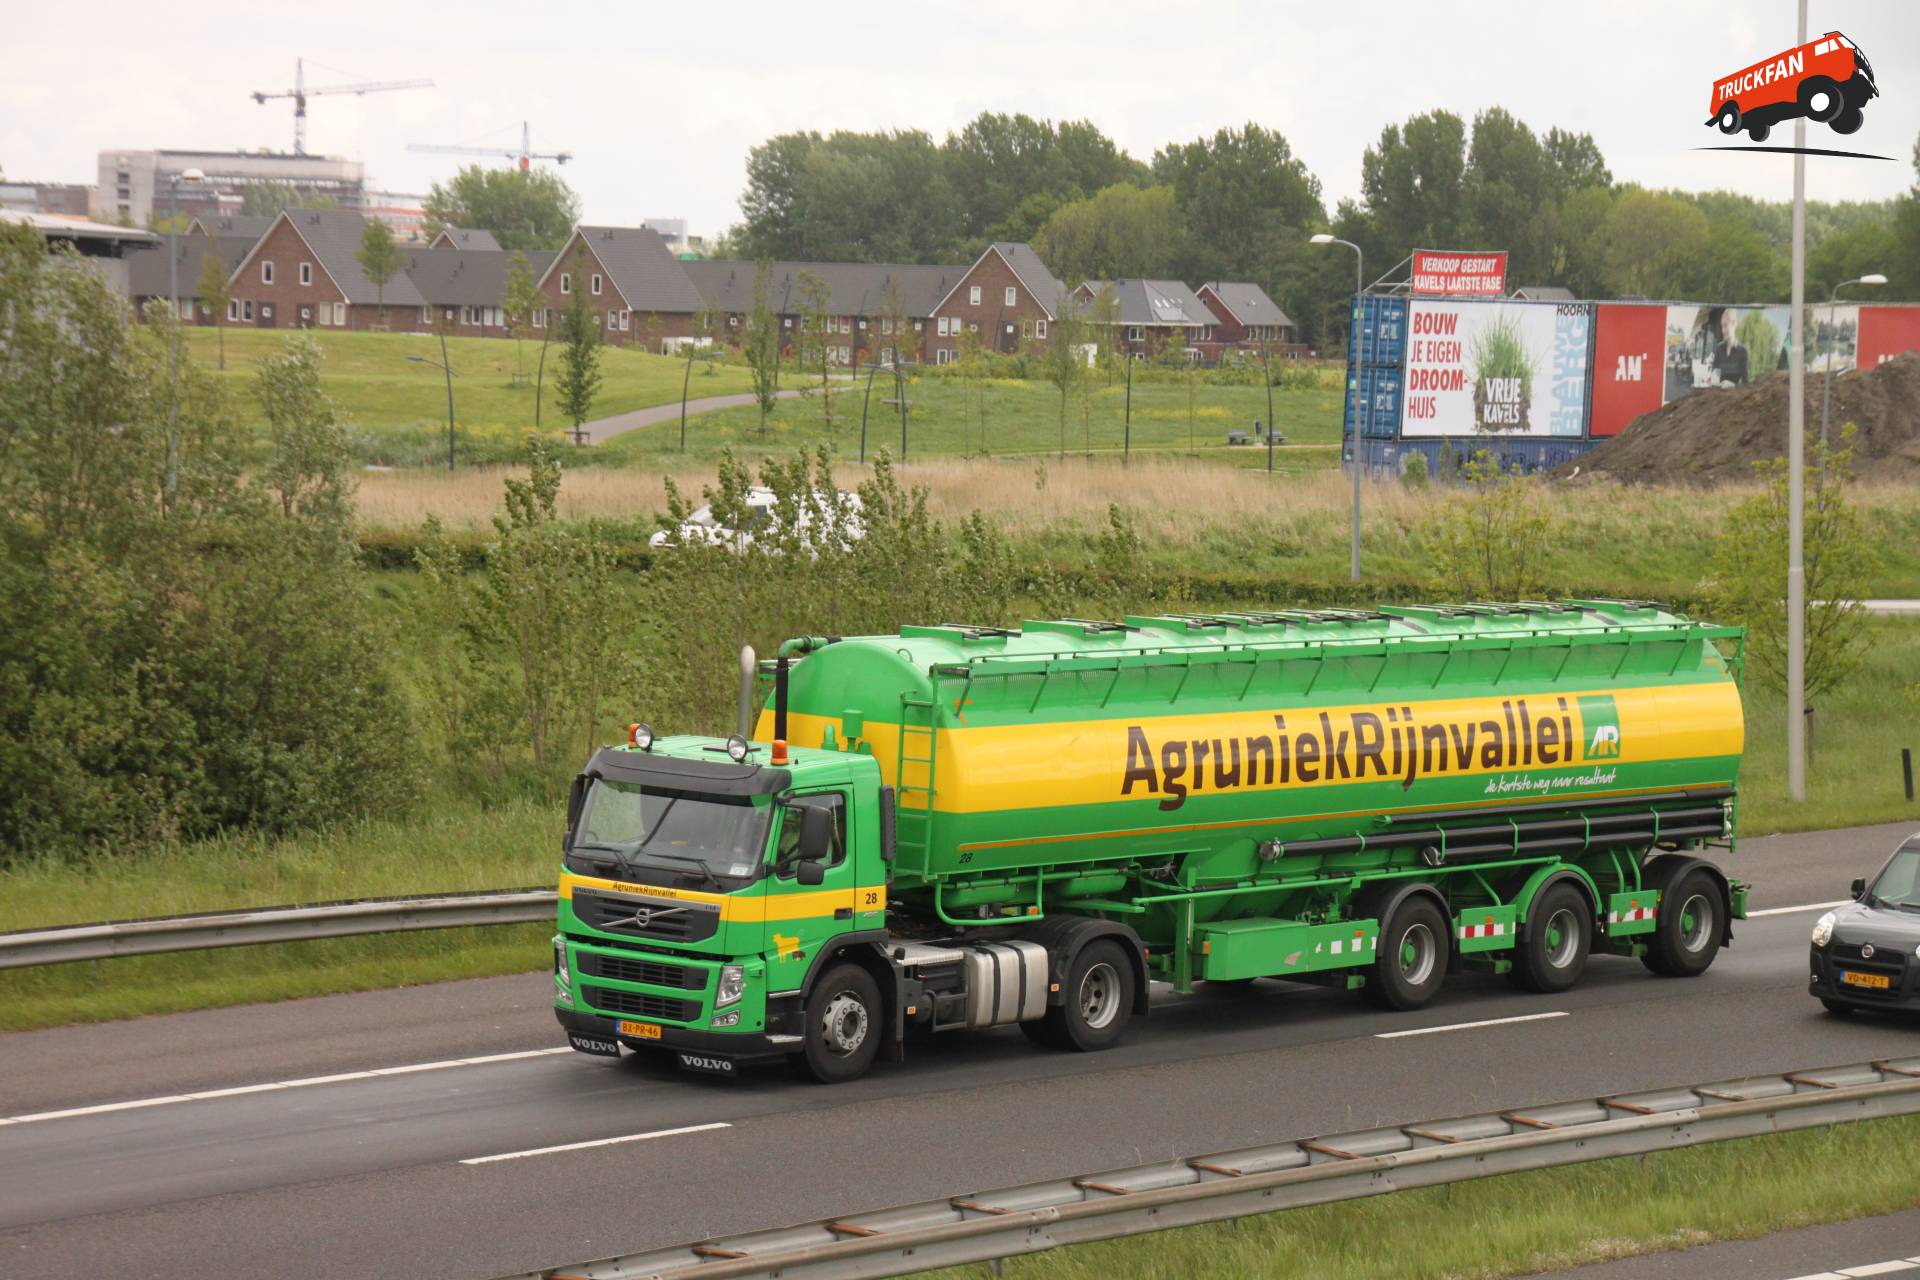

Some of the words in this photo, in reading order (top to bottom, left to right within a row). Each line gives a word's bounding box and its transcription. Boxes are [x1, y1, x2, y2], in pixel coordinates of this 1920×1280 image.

[1422, 257, 1459, 273] VERKOOP
[1461, 258, 1497, 273] GESTART
[1414, 275, 1445, 289] KAVELS
[1446, 276, 1481, 290] LAATSTE
[1482, 276, 1502, 290] FASE
[1557, 304, 1590, 317] HOORN
[1413, 312, 1458, 335] BOUW
[1411, 340, 1423, 363] JE
[1427, 340, 1461, 363] EIGEN
[1409, 368, 1468, 391] DROOM-
[1562, 316, 1589, 431] BERG
[1486, 378, 1522, 403] VRIJE
[1408, 397, 1436, 419] HUIS
[1483, 403, 1520, 424] KAVELS
[1121, 697, 1573, 811] AgruniekRijnvallei
[1484, 779, 1497, 794] de
[1533, 779, 1551, 794] weg
[1552, 776, 1574, 787] naar
[1575, 766, 1617, 785] resultaat
[959, 852, 973, 864] 28
[865, 892, 877, 904] 28
[622, 1022, 659, 1037] BX-PR-46
[573, 1037, 617, 1053] VOLVO
[681, 1055, 732, 1071] VOLVO
